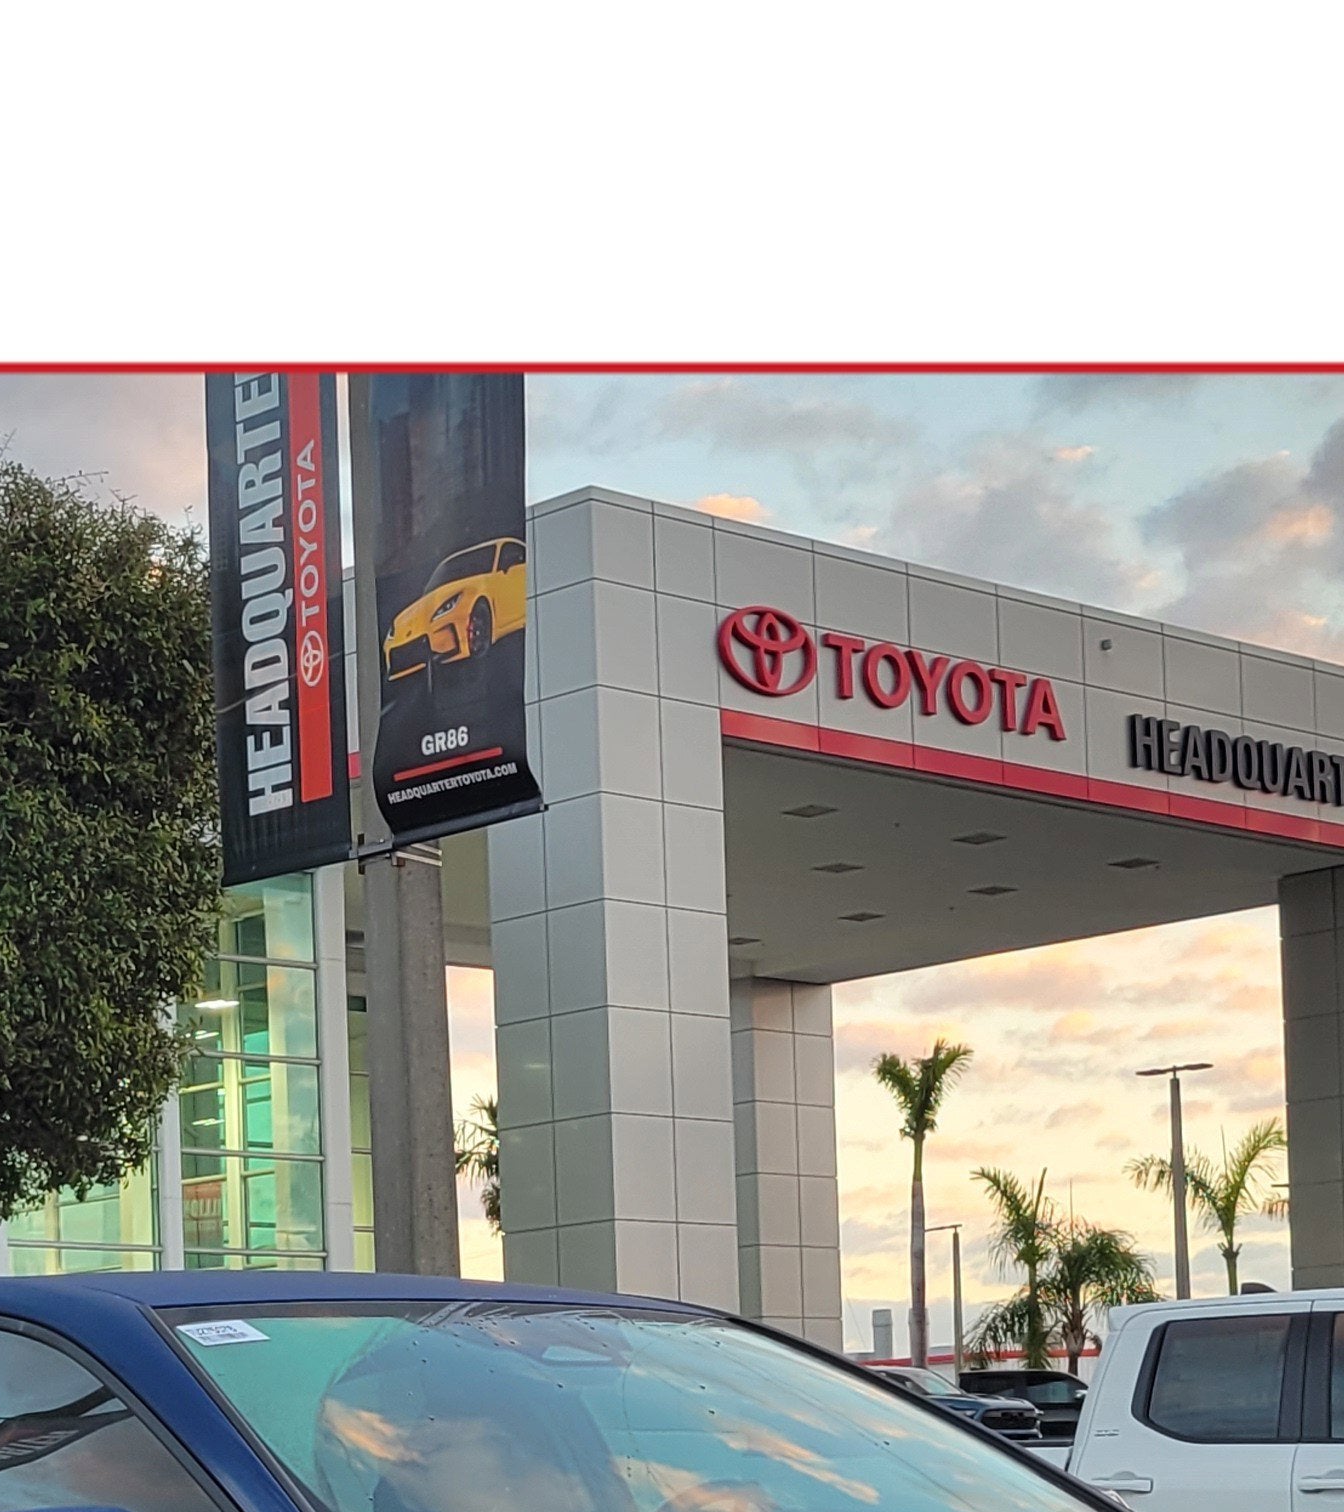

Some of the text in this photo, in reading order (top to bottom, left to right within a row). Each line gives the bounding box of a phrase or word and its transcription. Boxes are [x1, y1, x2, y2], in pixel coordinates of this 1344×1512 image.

[297, 439, 319, 627] TOYOTA
[822, 632, 1067, 742] TOYOTA
[421, 725, 469, 756] GR86
[387, 762, 518, 805] HEADQUARTERTOYOTA.COM
